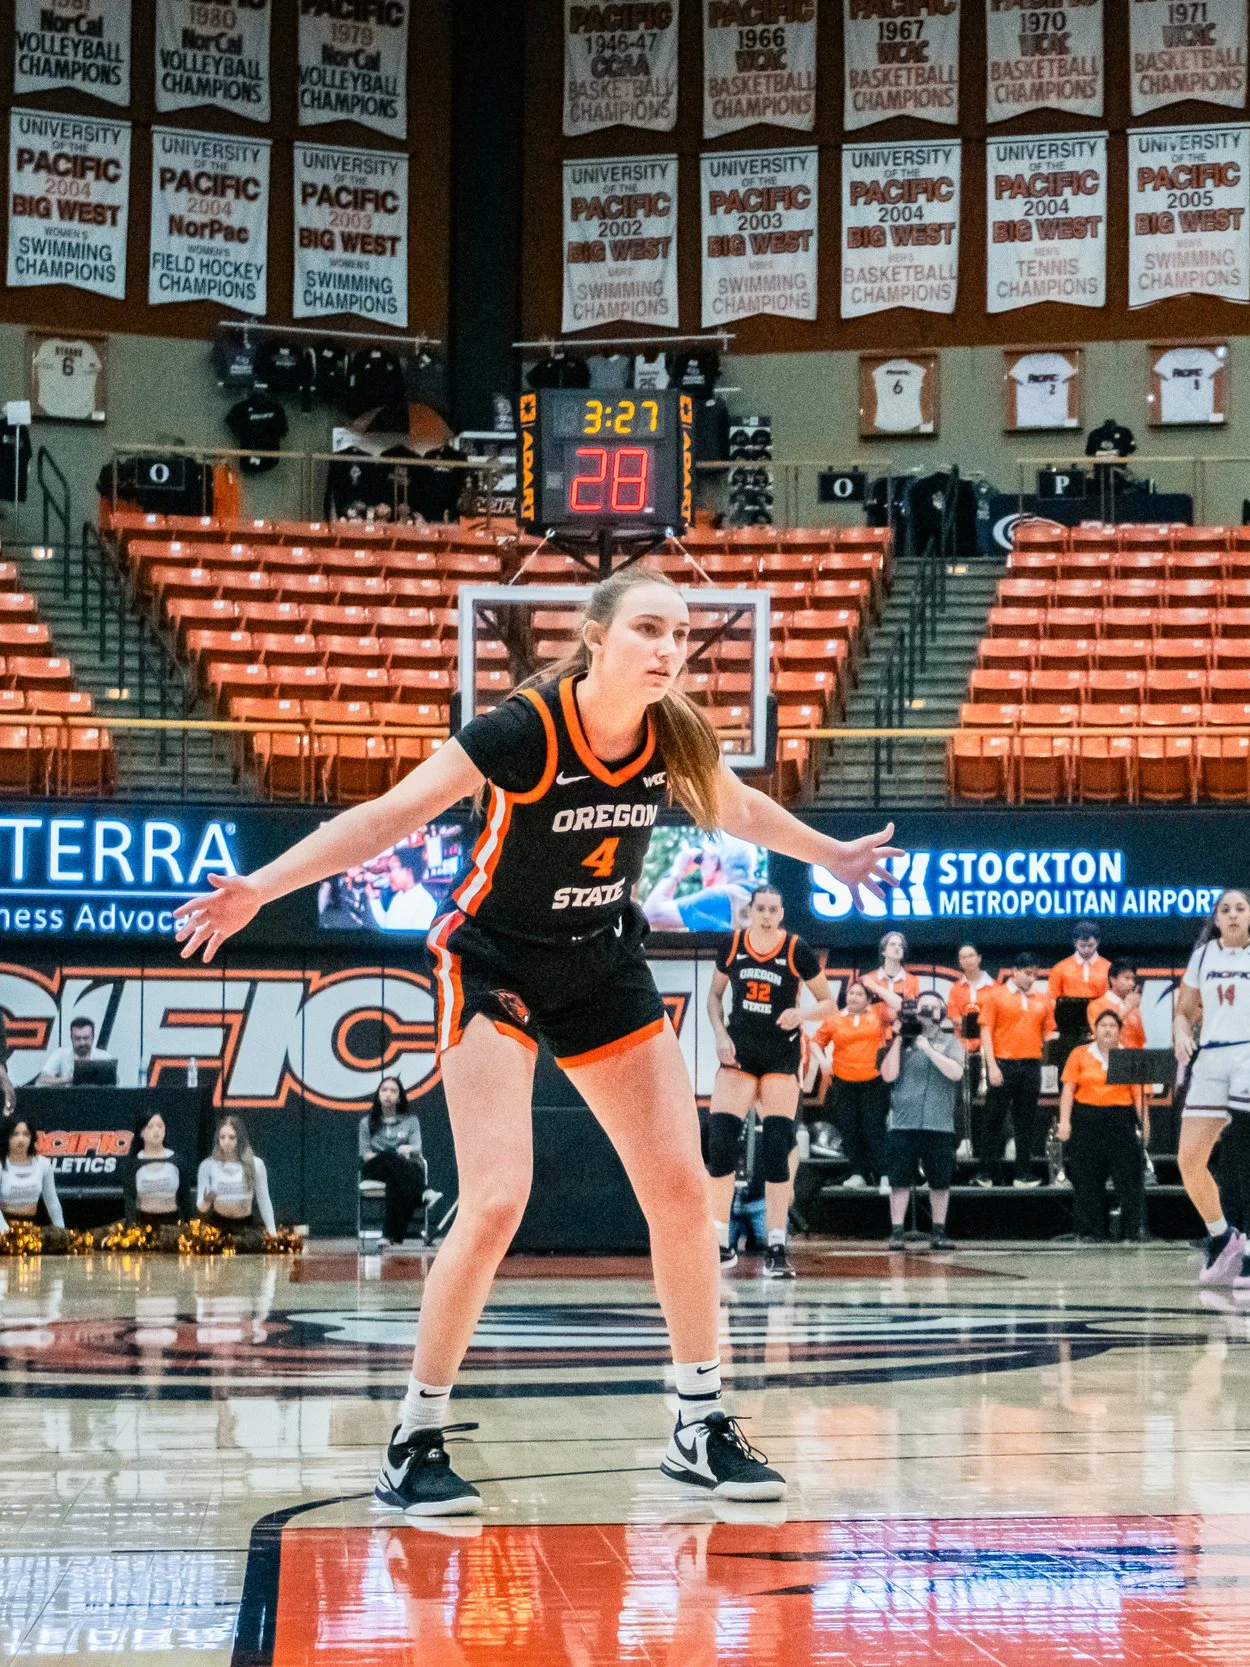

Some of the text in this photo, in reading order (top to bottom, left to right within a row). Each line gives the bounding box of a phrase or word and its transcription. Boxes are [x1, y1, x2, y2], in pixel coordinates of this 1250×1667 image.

[739, 28, 785, 49] 1966
[879, 20, 924, 41] 1967
[15, 31, 124, 64] VOLLEYBALL
[18, 54, 122, 86] CHAMPIONS
[160, 49, 264, 82] VOLLEYBALL
[162, 72, 262, 104] CHAMPIONS
[19, 118, 121, 145] UNIVERSITY
[1138, 133, 1242, 154] UNIVERSITY
[162, 138, 260, 163] UNIVERSITY
[303, 150, 398, 176] UNIVERSITY
[852, 148, 951, 168] UNIVERSITY
[996, 141, 1097, 162] UNIVERSITY
[16, 149, 122, 184] PACIFIC
[572, 163, 669, 184] UNIVERSITY
[710, 156, 808, 178] UNIVERSITY
[1137, 162, 1241, 192] PACIFIC
[45, 178, 91, 199] 2004
[160, 167, 261, 202] PACIFIC
[849, 177, 955, 206] PACIFIC
[995, 170, 1100, 200] PACIFIC
[12, 193, 120, 227] BIG WEST
[187, 197, 232, 217] 2004
[301, 182, 400, 215] PACIFIC
[570, 193, 671, 222] PACIFIC
[708, 185, 811, 216] PACIFIC
[1024, 200, 1070, 217] 2004
[1167, 191, 1213, 209] 2005
[738, 213, 783, 232] 2003
[879, 206, 924, 223] 2004
[1135, 207, 1245, 236] BIG WEST
[169, 214, 249, 243] NorPac
[598, 221, 643, 238] 2002
[847, 222, 957, 249] BIG WEST
[993, 215, 1102, 243] BIG WEST
[19, 236, 112, 263] SWIMMING
[300, 228, 401, 257] BIG WEST
[567, 237, 672, 263] BIG WEST
[707, 229, 814, 258] BIG WEST
[15, 257, 116, 284] CHAMPIONS
[152, 253, 263, 281] FIELD HOCKEY
[1016, 258, 1079, 278] TENNIS
[160, 273, 256, 301] CHAMPIONS
[306, 271, 393, 294] SWIMMING
[303, 289, 398, 315] CHAMPIONS
[62, 357, 74, 377] 6
[893, 379, 903, 395] 6
[584, 400, 658, 434] 3:27
[150, 463, 169, 484] O
[570, 447, 648, 512] 28
[1054, 475, 1070, 494] P
[833, 478, 853, 497] O
[552, 804, 658, 833] OREGON
[581, 837, 620, 877] 4
[939, 851, 1122, 884] STOCKTON
[552, 877, 626, 910] STATE
[939, 889, 1116, 915] METROPOLITAN
[739, 967, 782, 986] OREGON
[745, 981, 771, 1002] 32
[1217, 984, 1235, 1006] 14
[742, 999, 772, 1014] STATE
